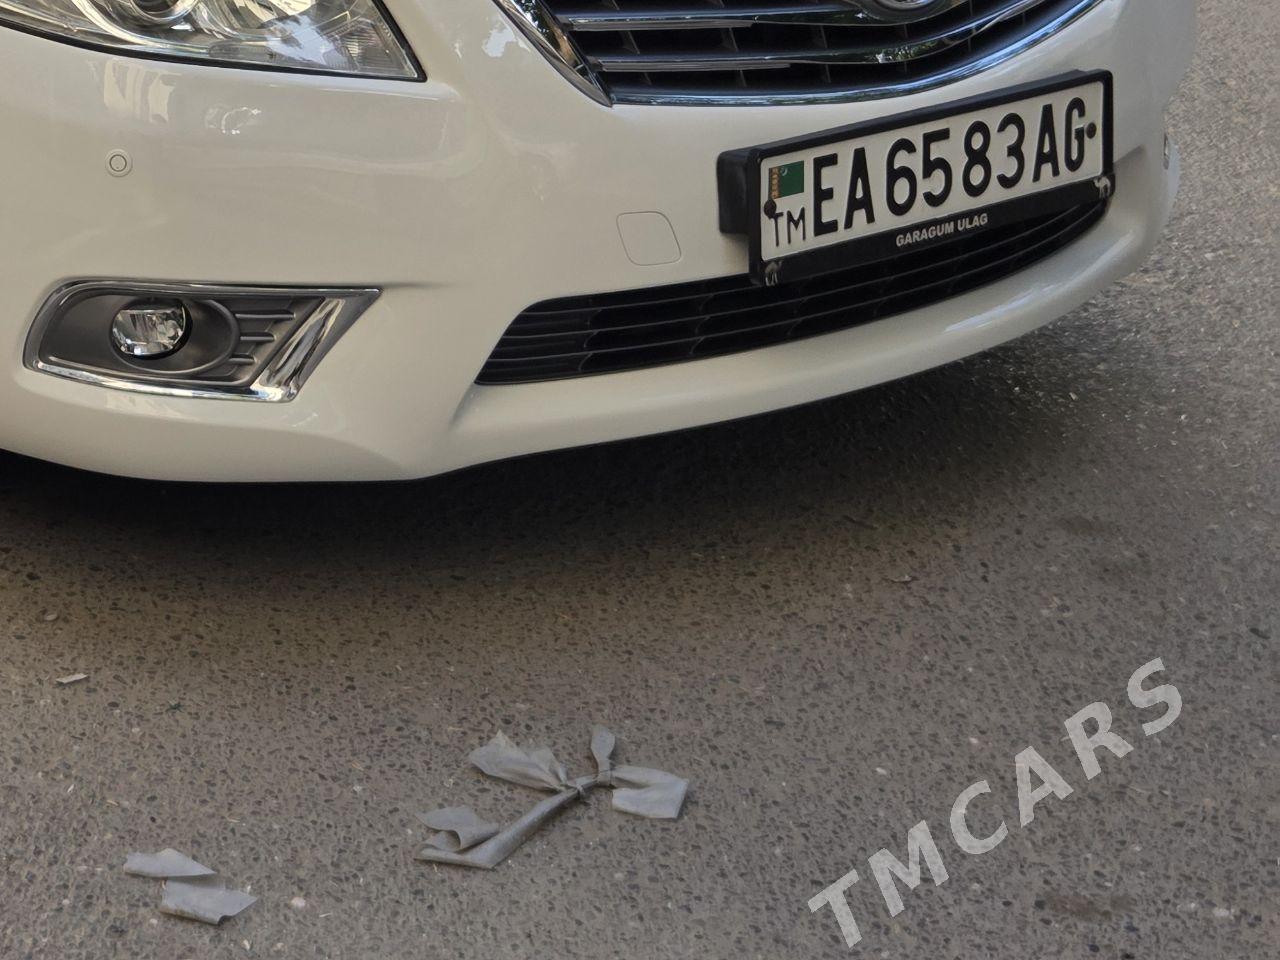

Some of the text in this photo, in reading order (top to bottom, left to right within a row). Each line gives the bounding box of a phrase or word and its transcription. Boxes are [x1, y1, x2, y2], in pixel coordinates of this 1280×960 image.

[770, 97, 1085, 247] TM EA6583AG
[896, 213, 988, 246] GARAGUM ULAG
